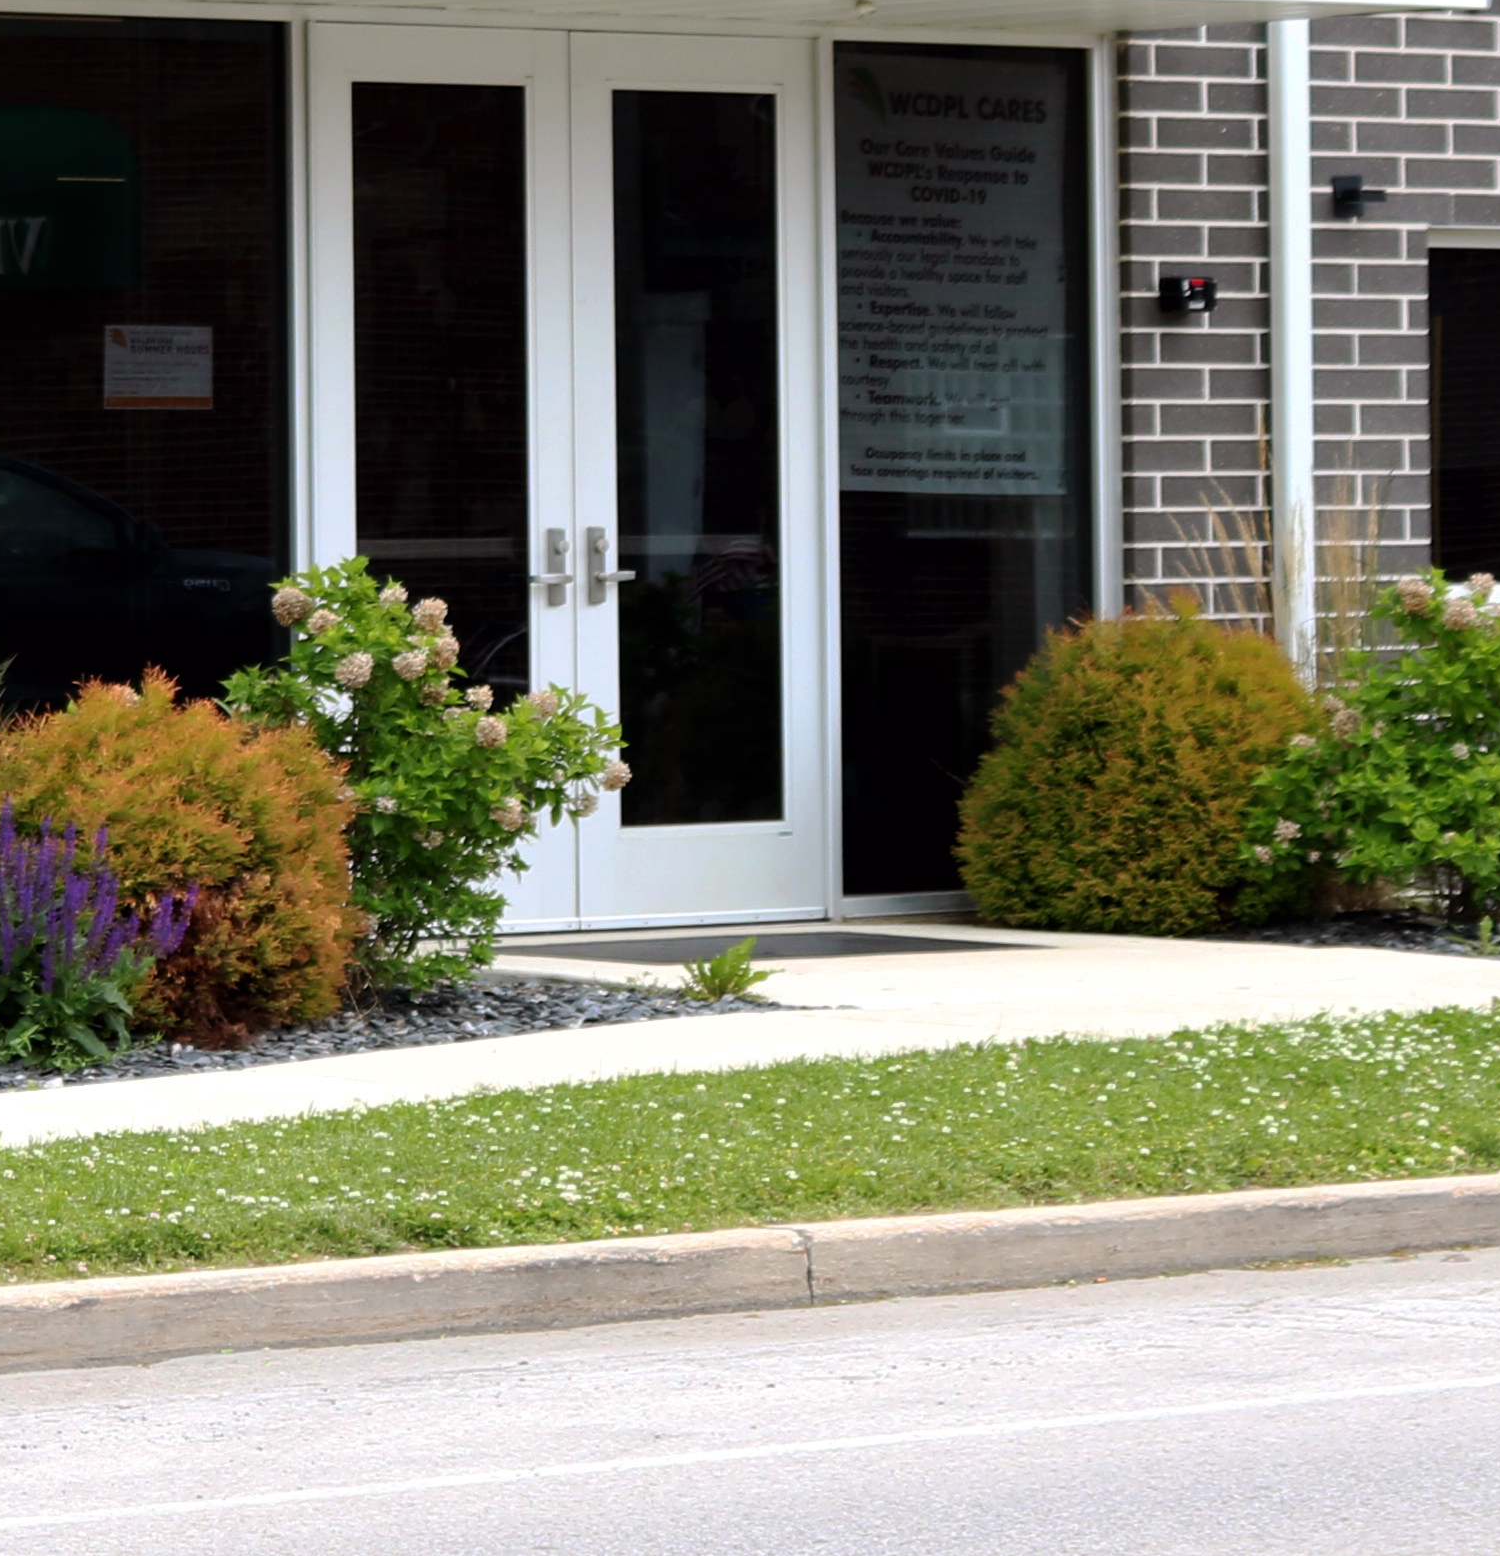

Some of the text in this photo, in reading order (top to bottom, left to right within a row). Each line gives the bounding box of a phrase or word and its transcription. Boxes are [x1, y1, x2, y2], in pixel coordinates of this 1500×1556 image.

[889, 92, 1047, 124] WCDPL CARES
[860, 138, 1037, 163] Our Core Values Guide
[867, 161, 1029, 185] WCDPL's Response to
[910, 185, 987, 204] COVID-19
[841, 210, 895, 226] Because
[899, 216, 917, 227] we
[968, 233, 988, 247] We
[991, 234, 1012, 248] will
[841, 247, 1021, 267] seriously our legal mandate to
[841, 265, 886, 282] provide
[889, 269, 898, 280] a
[900, 266, 945, 285] healthy
[948, 271, 983, 285] space
[985, 268, 1003, 283] for
[841, 284, 864, 296] and
[870, 300, 1018, 319] Expertise. We will follow
[862, 336, 902, 351] health
[905, 338, 929, 352] and
[869, 354, 924, 372] Respect.
[867, 390, 942, 406] Teamwork.
[841, 408, 886, 426] through
[889, 408, 911, 423] this
